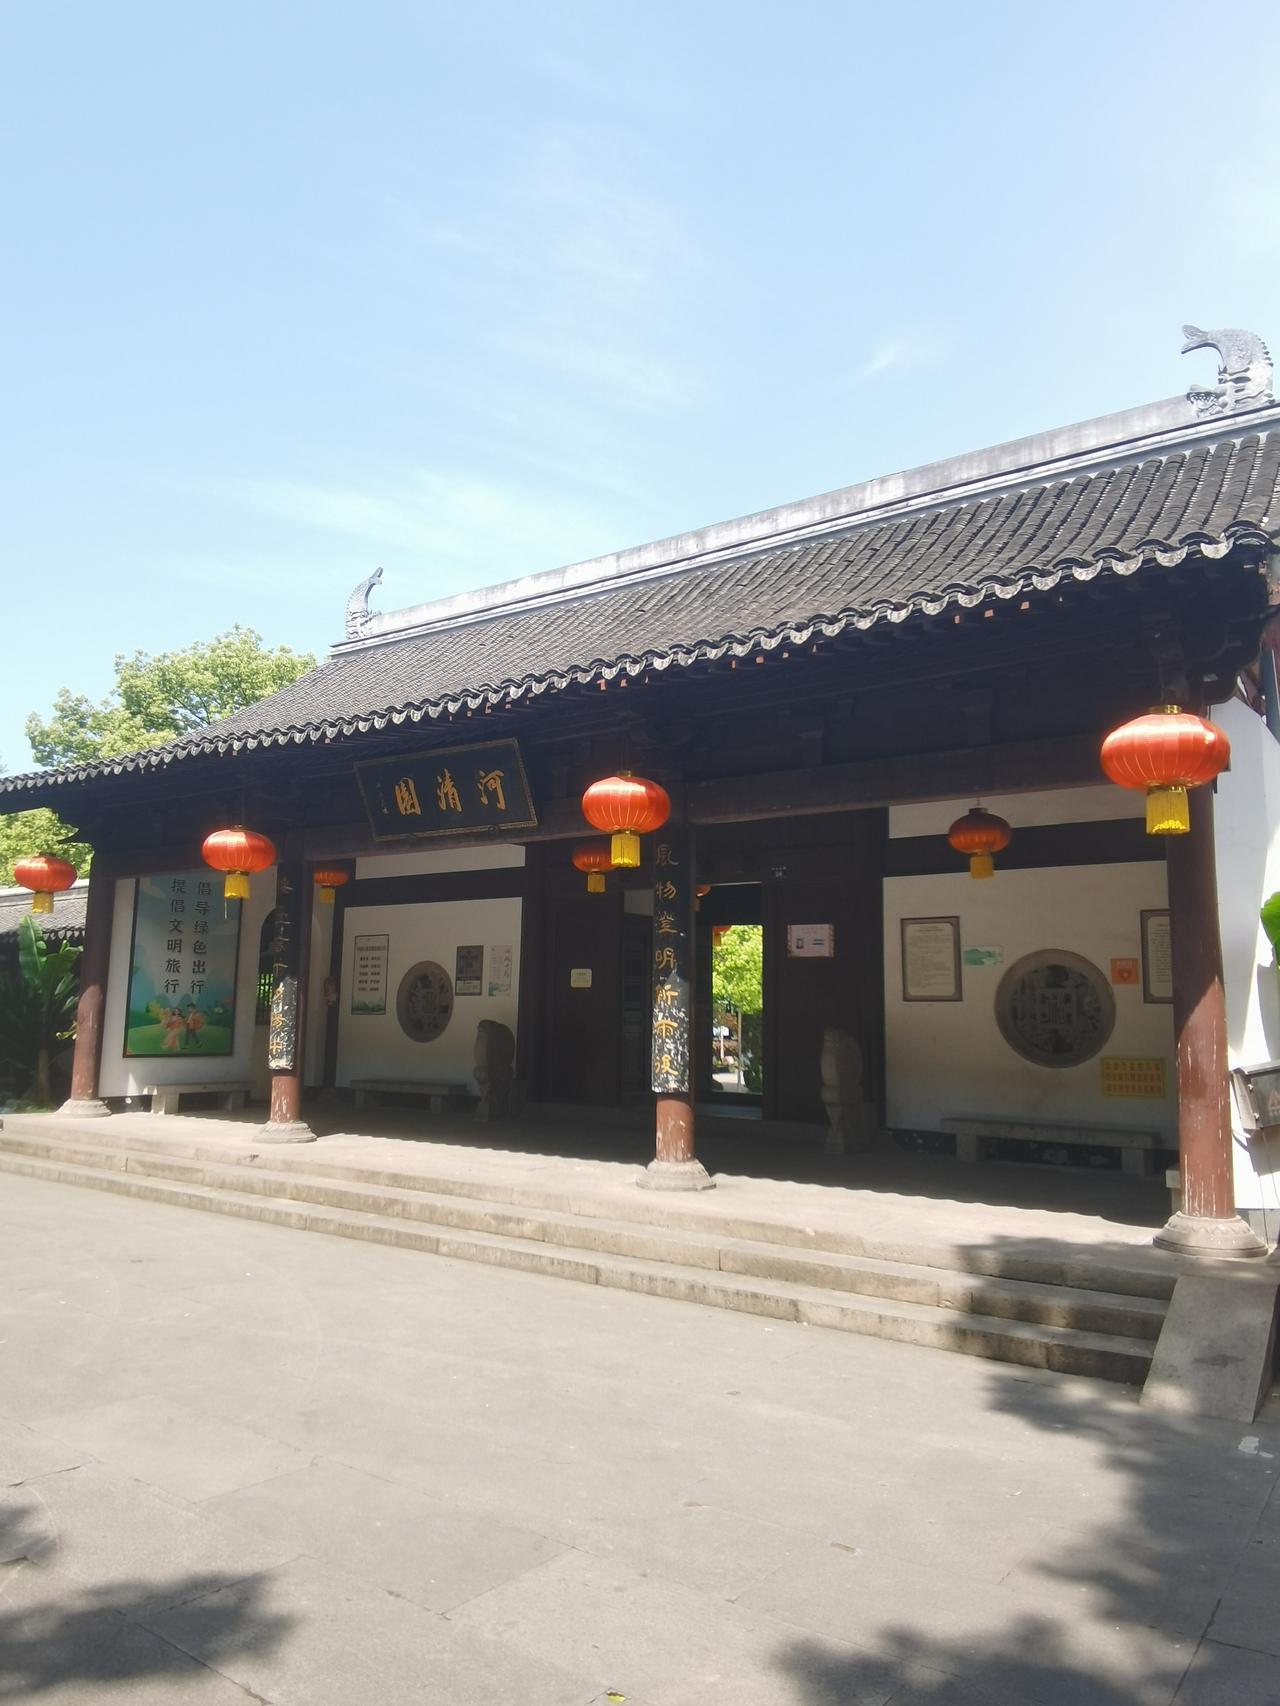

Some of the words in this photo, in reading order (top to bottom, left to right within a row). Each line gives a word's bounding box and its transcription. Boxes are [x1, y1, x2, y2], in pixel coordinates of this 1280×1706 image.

[164, 878, 187, 994] 提倡文明旅行
[190, 881, 212, 995] 倡导绿色出行
